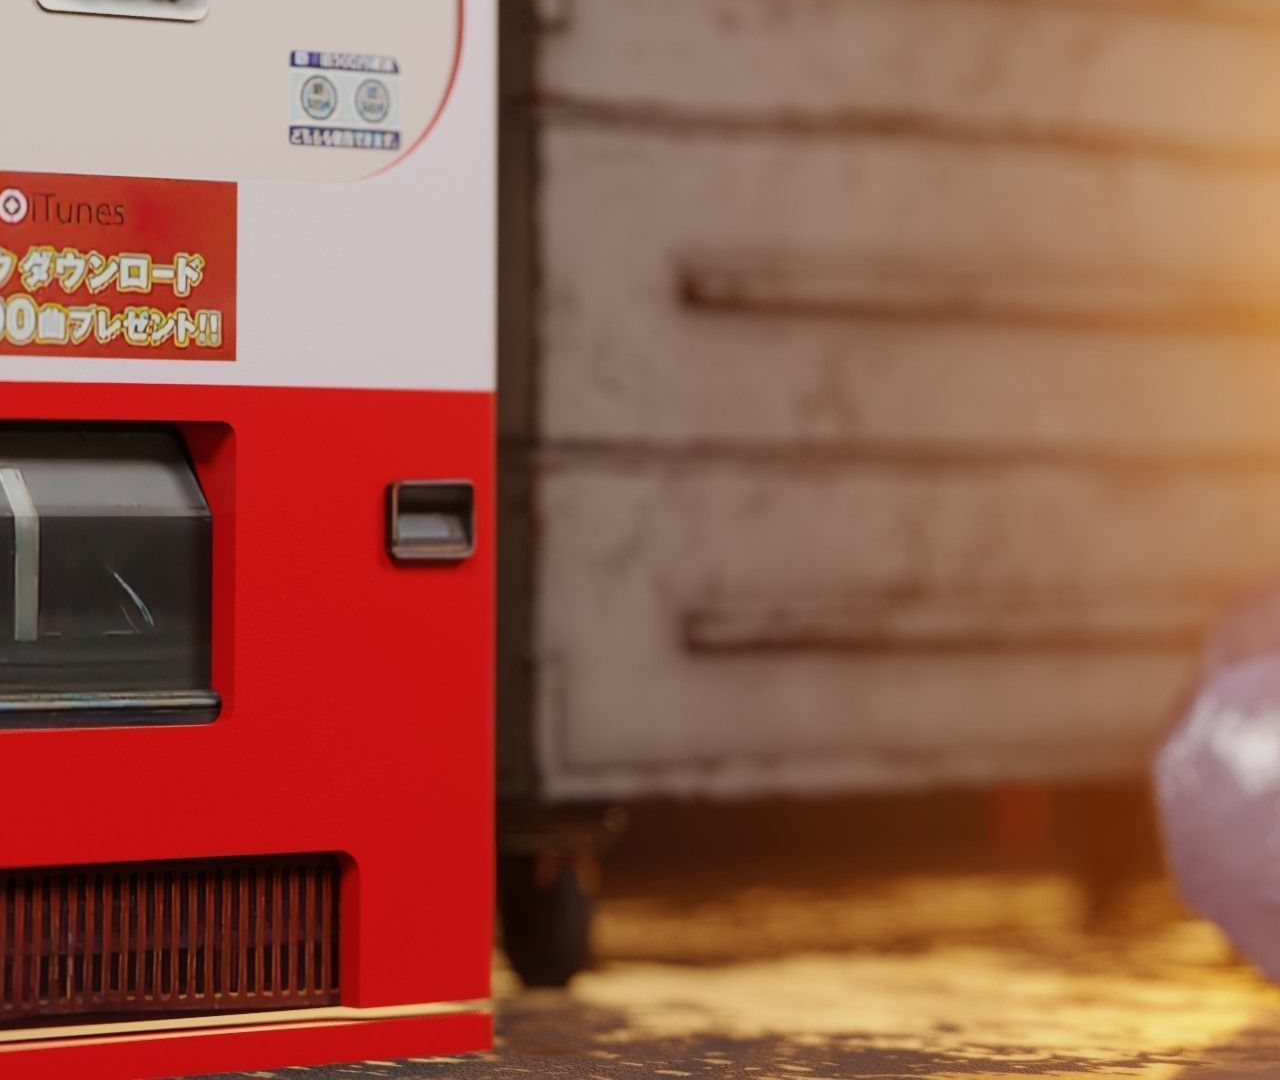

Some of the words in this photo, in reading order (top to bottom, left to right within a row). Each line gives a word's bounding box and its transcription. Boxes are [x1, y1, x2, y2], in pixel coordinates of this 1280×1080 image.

[30, 191, 126, 227] iTunes
[19, 245, 206, 298] ダウンロード
